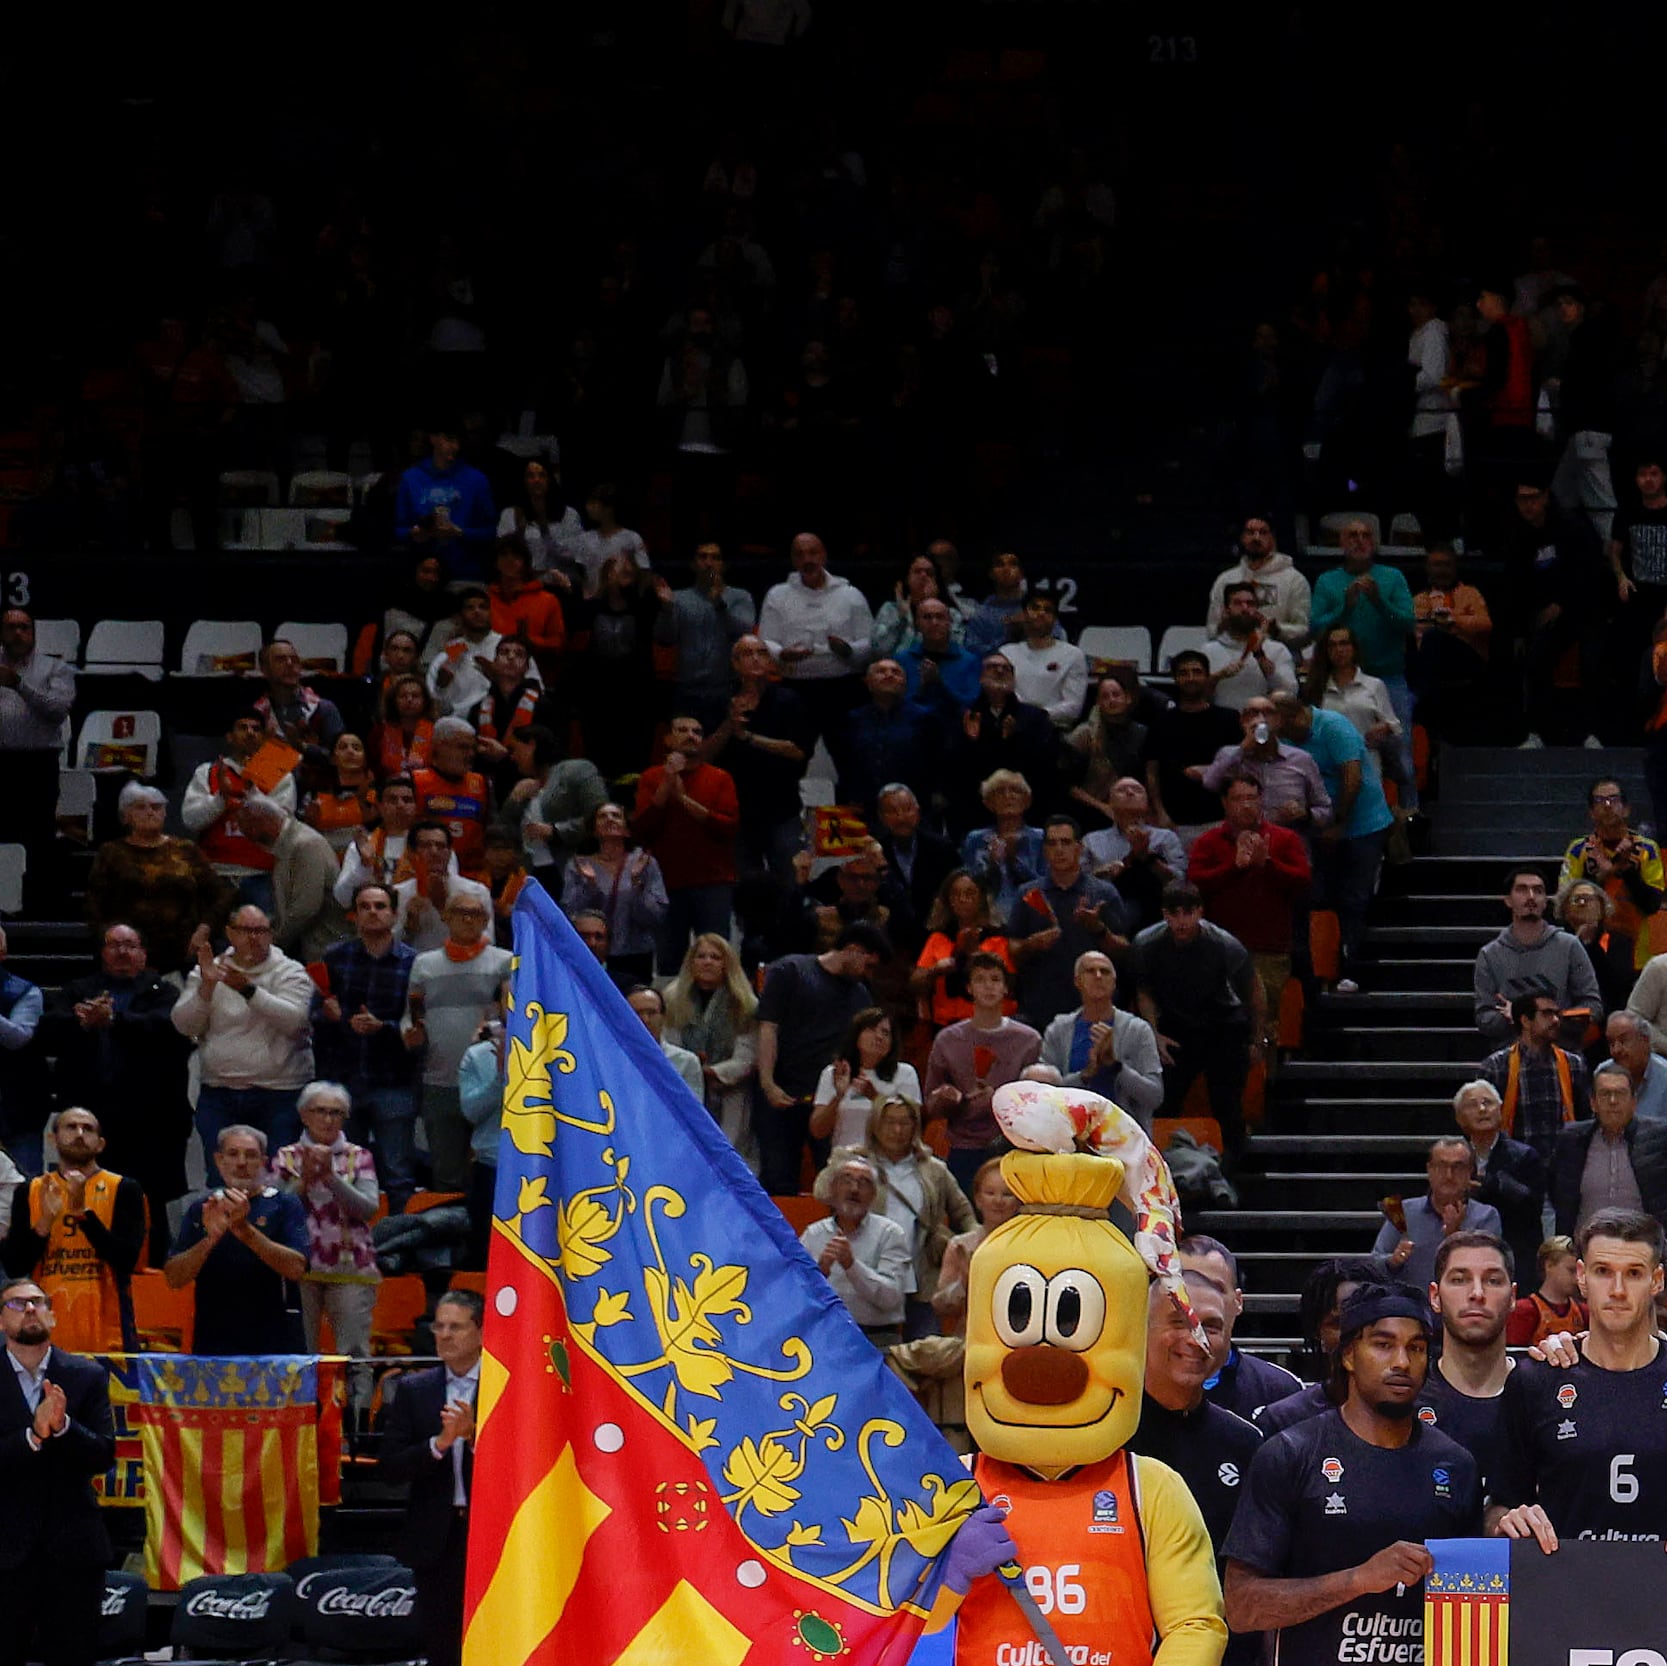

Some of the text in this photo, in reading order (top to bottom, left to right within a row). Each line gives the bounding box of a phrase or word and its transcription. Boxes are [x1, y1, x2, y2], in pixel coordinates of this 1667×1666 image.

[1147, 34, 1199, 63] 213
[1610, 1454, 1639, 1503] 6
[1090, 1652, 1112, 1666] del
[1338, 1637, 1425, 1663] Esfuerz
